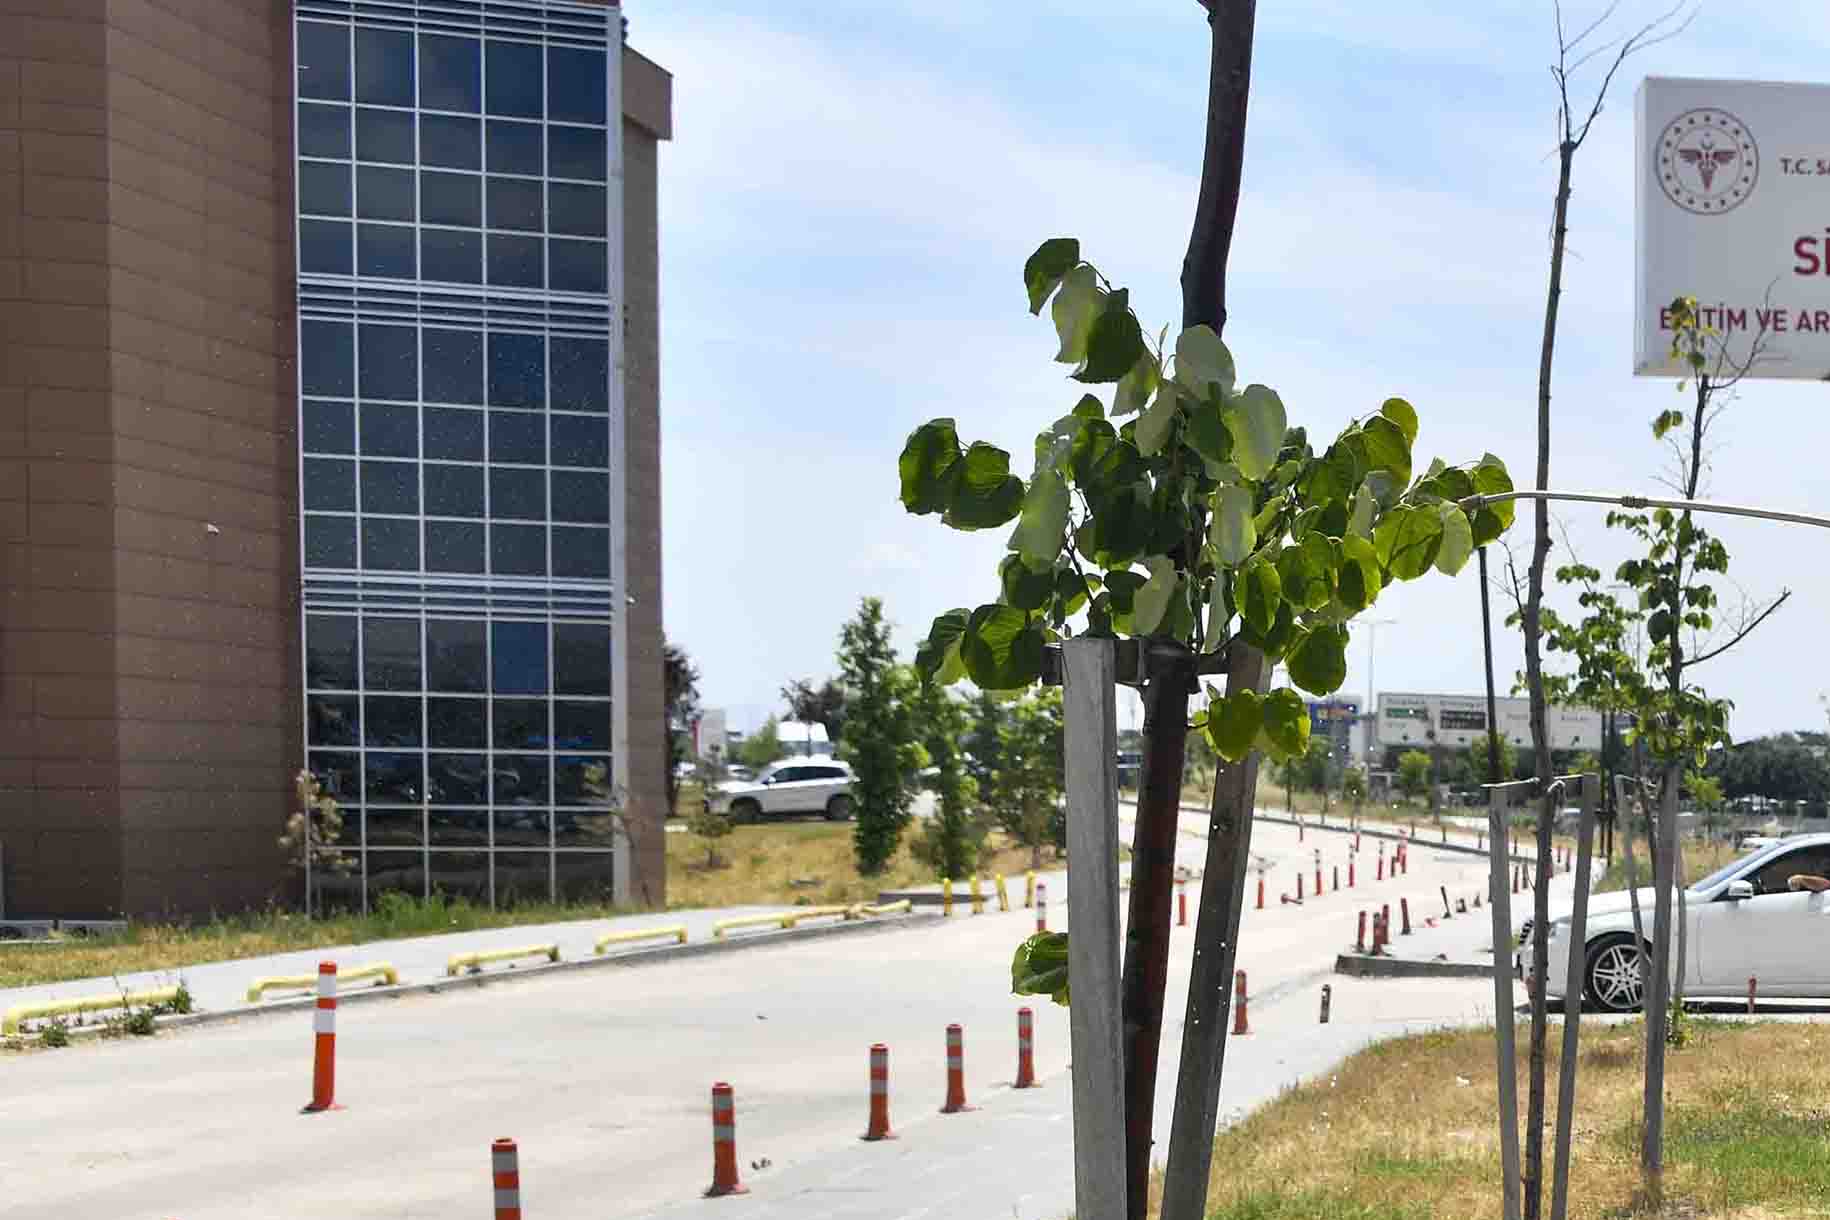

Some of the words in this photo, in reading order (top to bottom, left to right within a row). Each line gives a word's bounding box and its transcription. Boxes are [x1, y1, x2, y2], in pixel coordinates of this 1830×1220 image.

[1780, 158, 1812, 176] T.C.
[1659, 302, 1747, 330] EİTİM
[1755, 309, 1787, 332] VE
